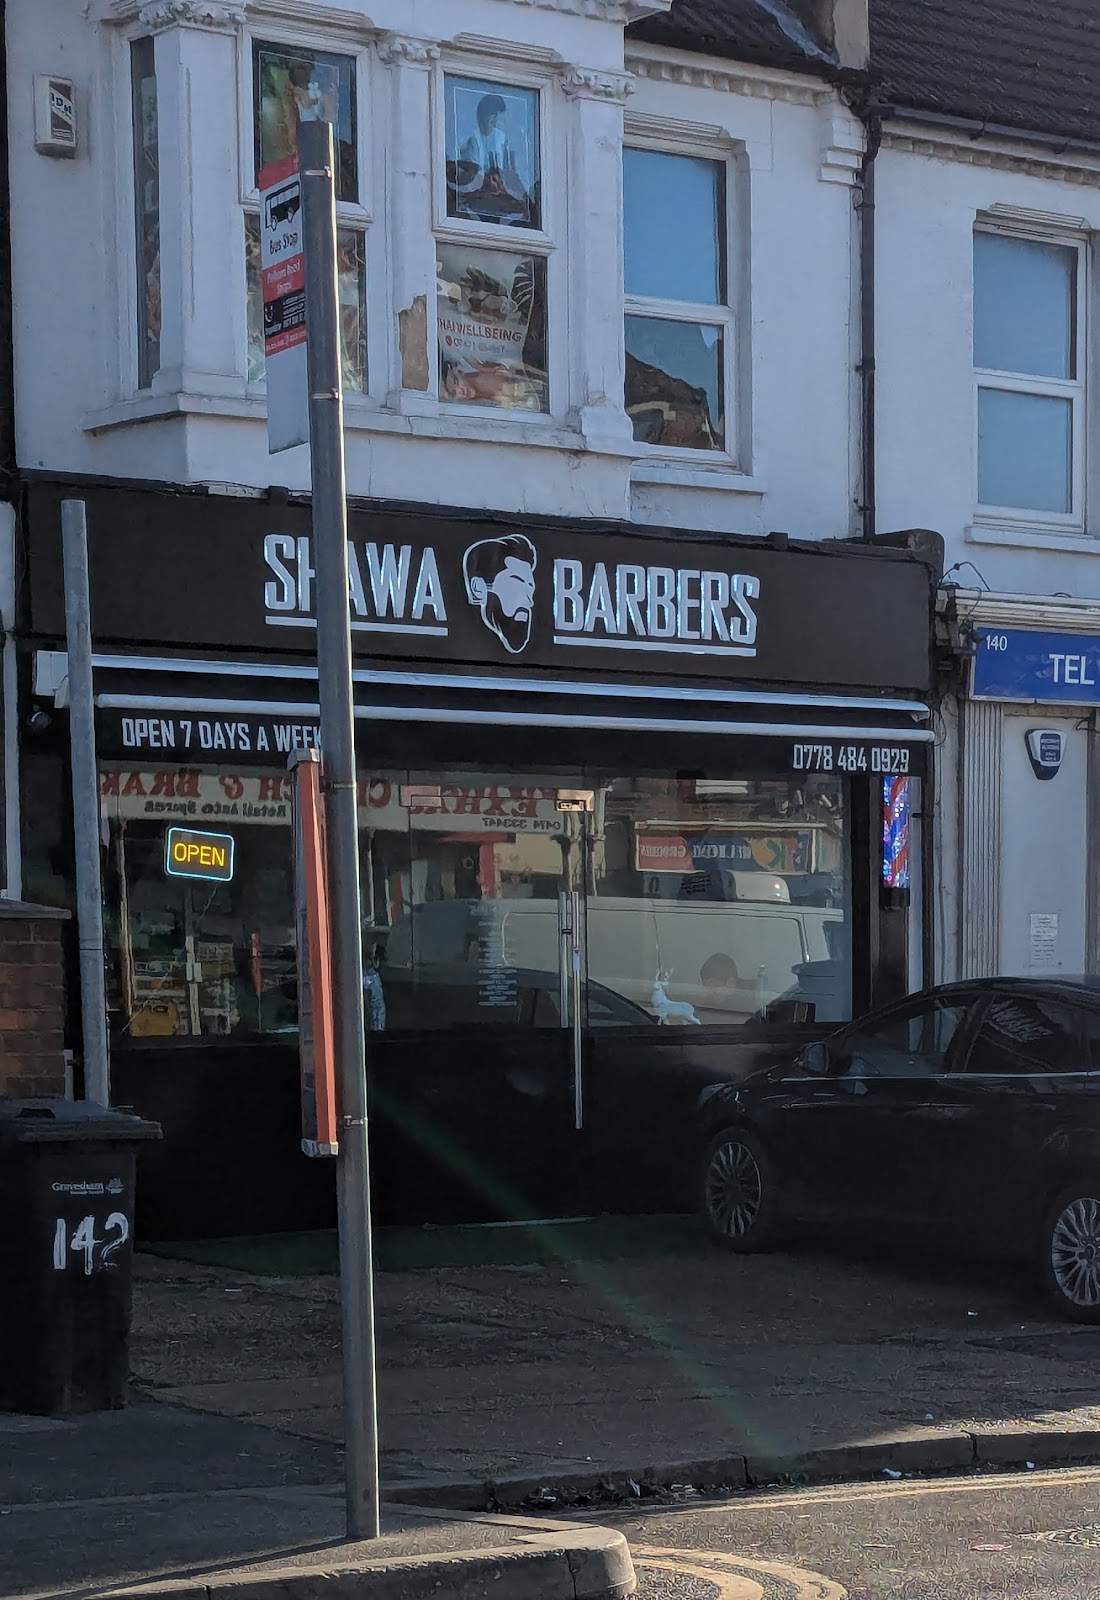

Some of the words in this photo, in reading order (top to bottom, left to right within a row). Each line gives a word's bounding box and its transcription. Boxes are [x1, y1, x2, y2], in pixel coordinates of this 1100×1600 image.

[553, 558, 760, 645] BARBERS
[986, 635, 1008, 652] 140
[1048, 653, 1096, 686] TEL
[121, 717, 175, 748] OPEN
[180, 720, 192, 748] 7
[198, 720, 251, 751] DAYS
[256, 726, 270, 751] A
[273, 724, 322, 752] WEEK
[792, 743, 833, 771] 0778
[837, 745, 868, 772] 484
[871, 747, 910, 773] 0929
[174, 842, 225, 867] OPEN
[53, 1211, 130, 1276] 142
